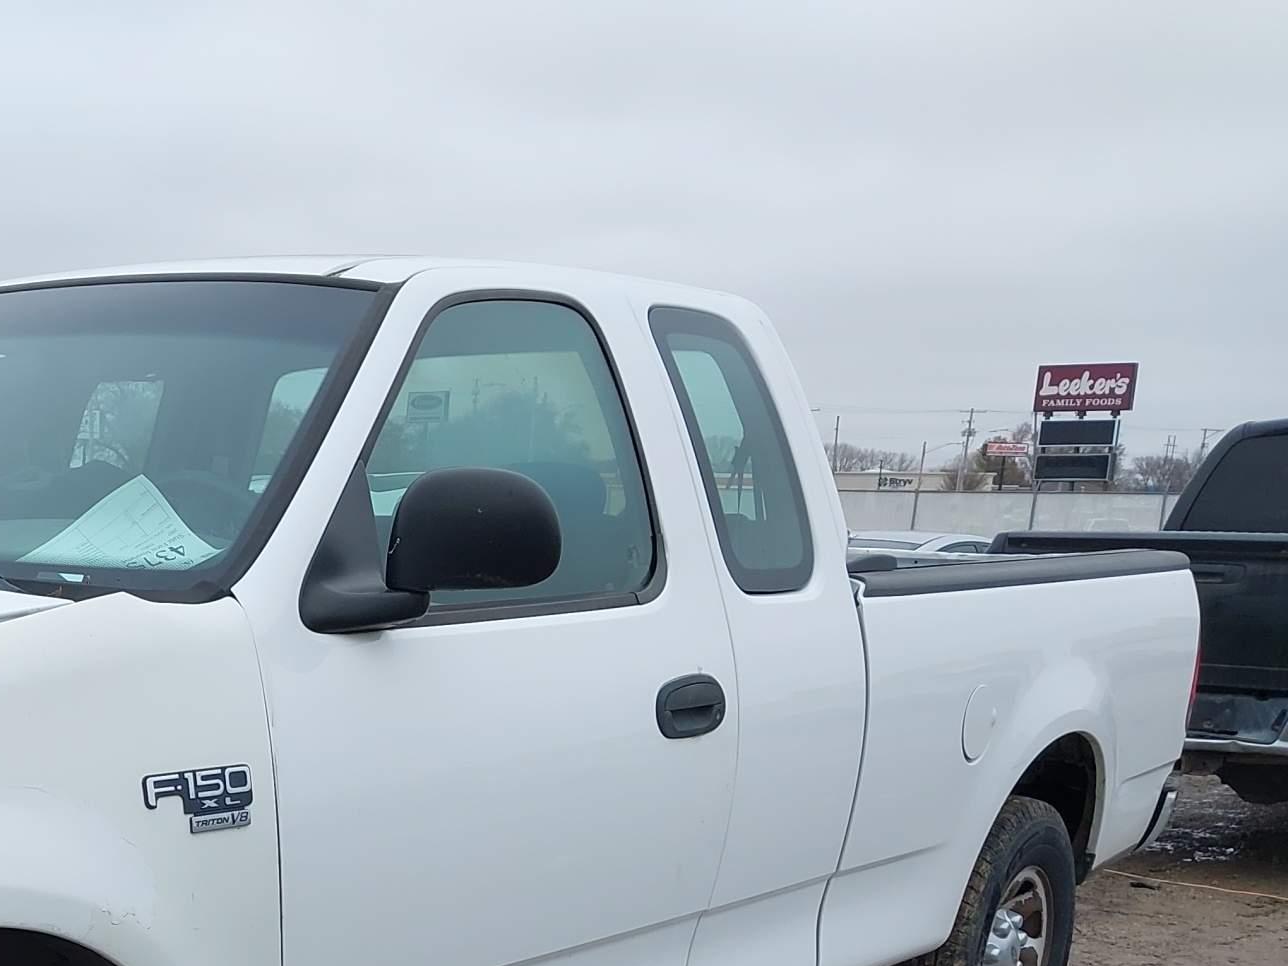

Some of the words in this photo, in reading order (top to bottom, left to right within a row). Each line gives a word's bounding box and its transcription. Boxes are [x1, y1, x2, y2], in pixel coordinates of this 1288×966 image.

[1039, 371, 1129, 396] Leeker's
[1042, 399, 1082, 407] FAMILY
[1086, 398, 1122, 407] FOODS
[201, 797, 241, 809] XL
[194, 817, 230, 828] TRITON
[231, 811, 249, 825] V8
